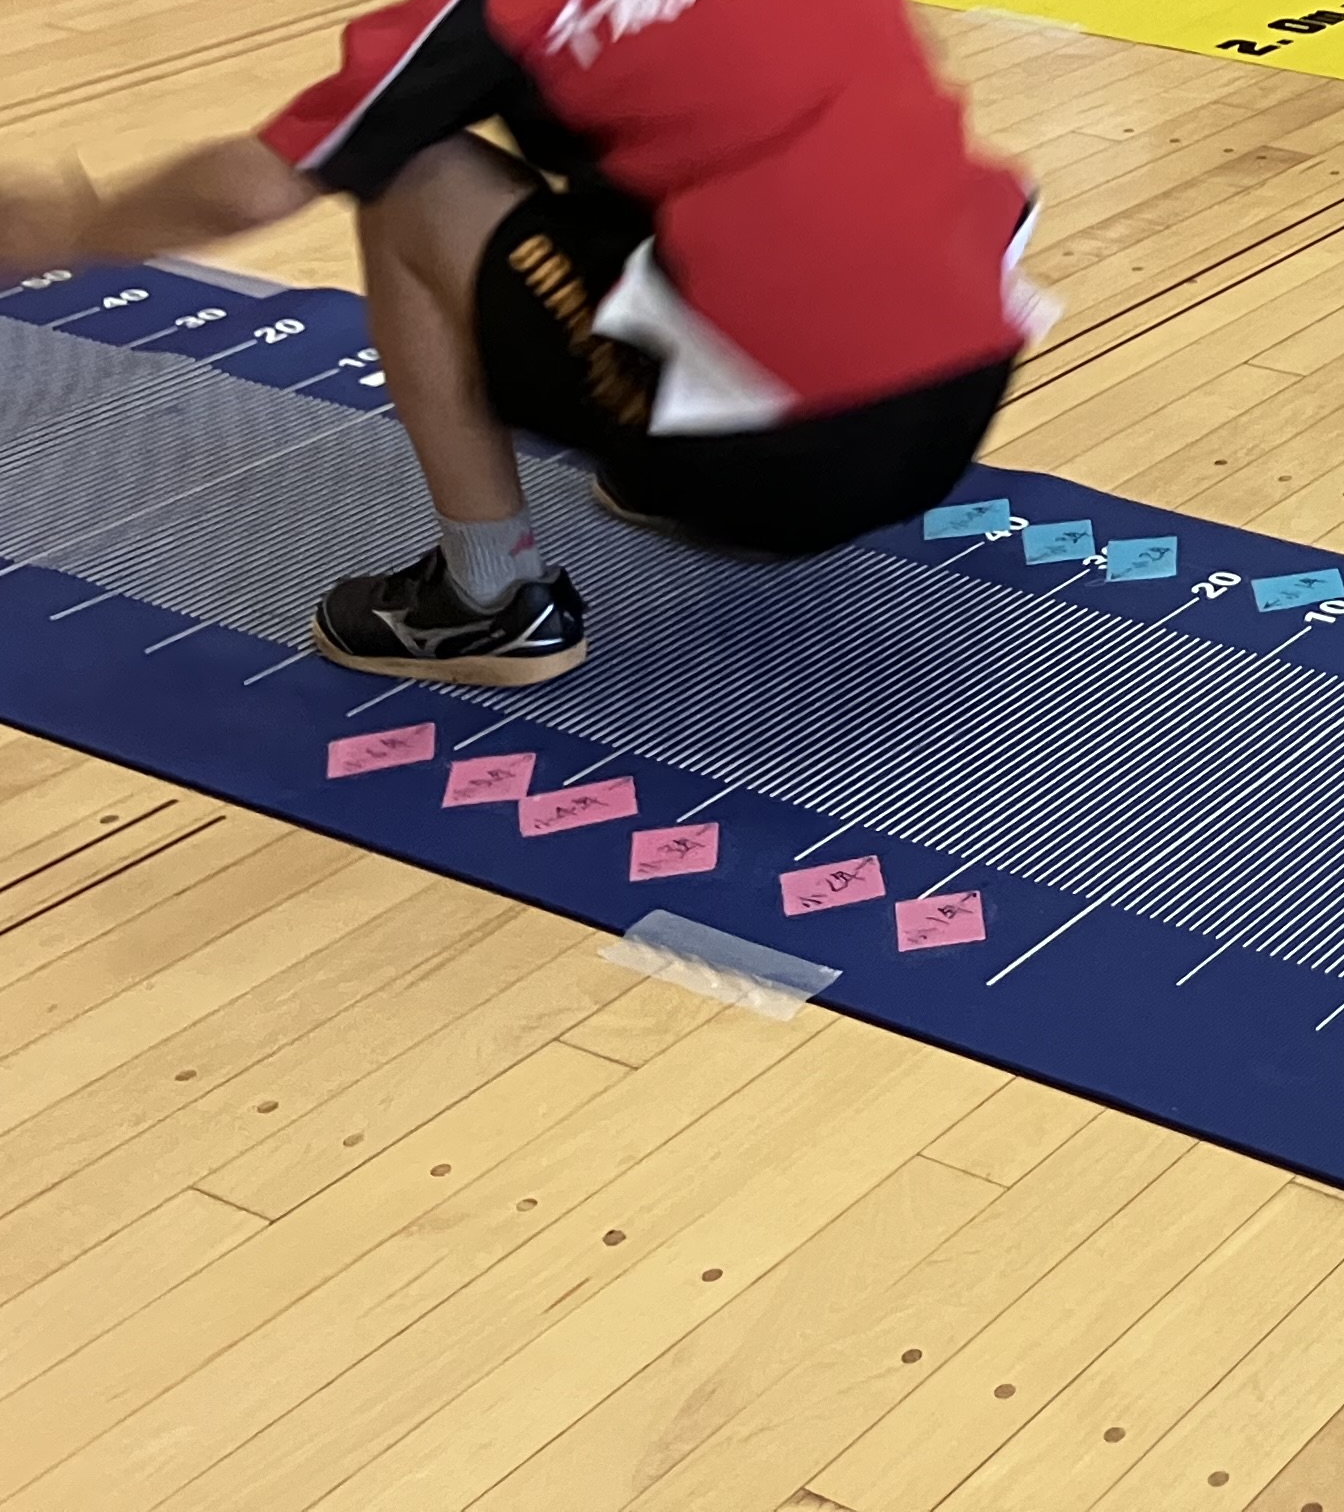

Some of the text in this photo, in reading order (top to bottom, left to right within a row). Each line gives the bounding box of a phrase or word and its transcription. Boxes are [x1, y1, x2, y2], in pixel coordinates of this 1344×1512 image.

[103, 288, 149, 309] 40
[175, 308, 227, 329] 30
[254, 318, 305, 344] 20
[338, 347, 380, 368] 10
[1082, 546, 1108, 569] 3
[1191, 572, 1242, 599] 20
